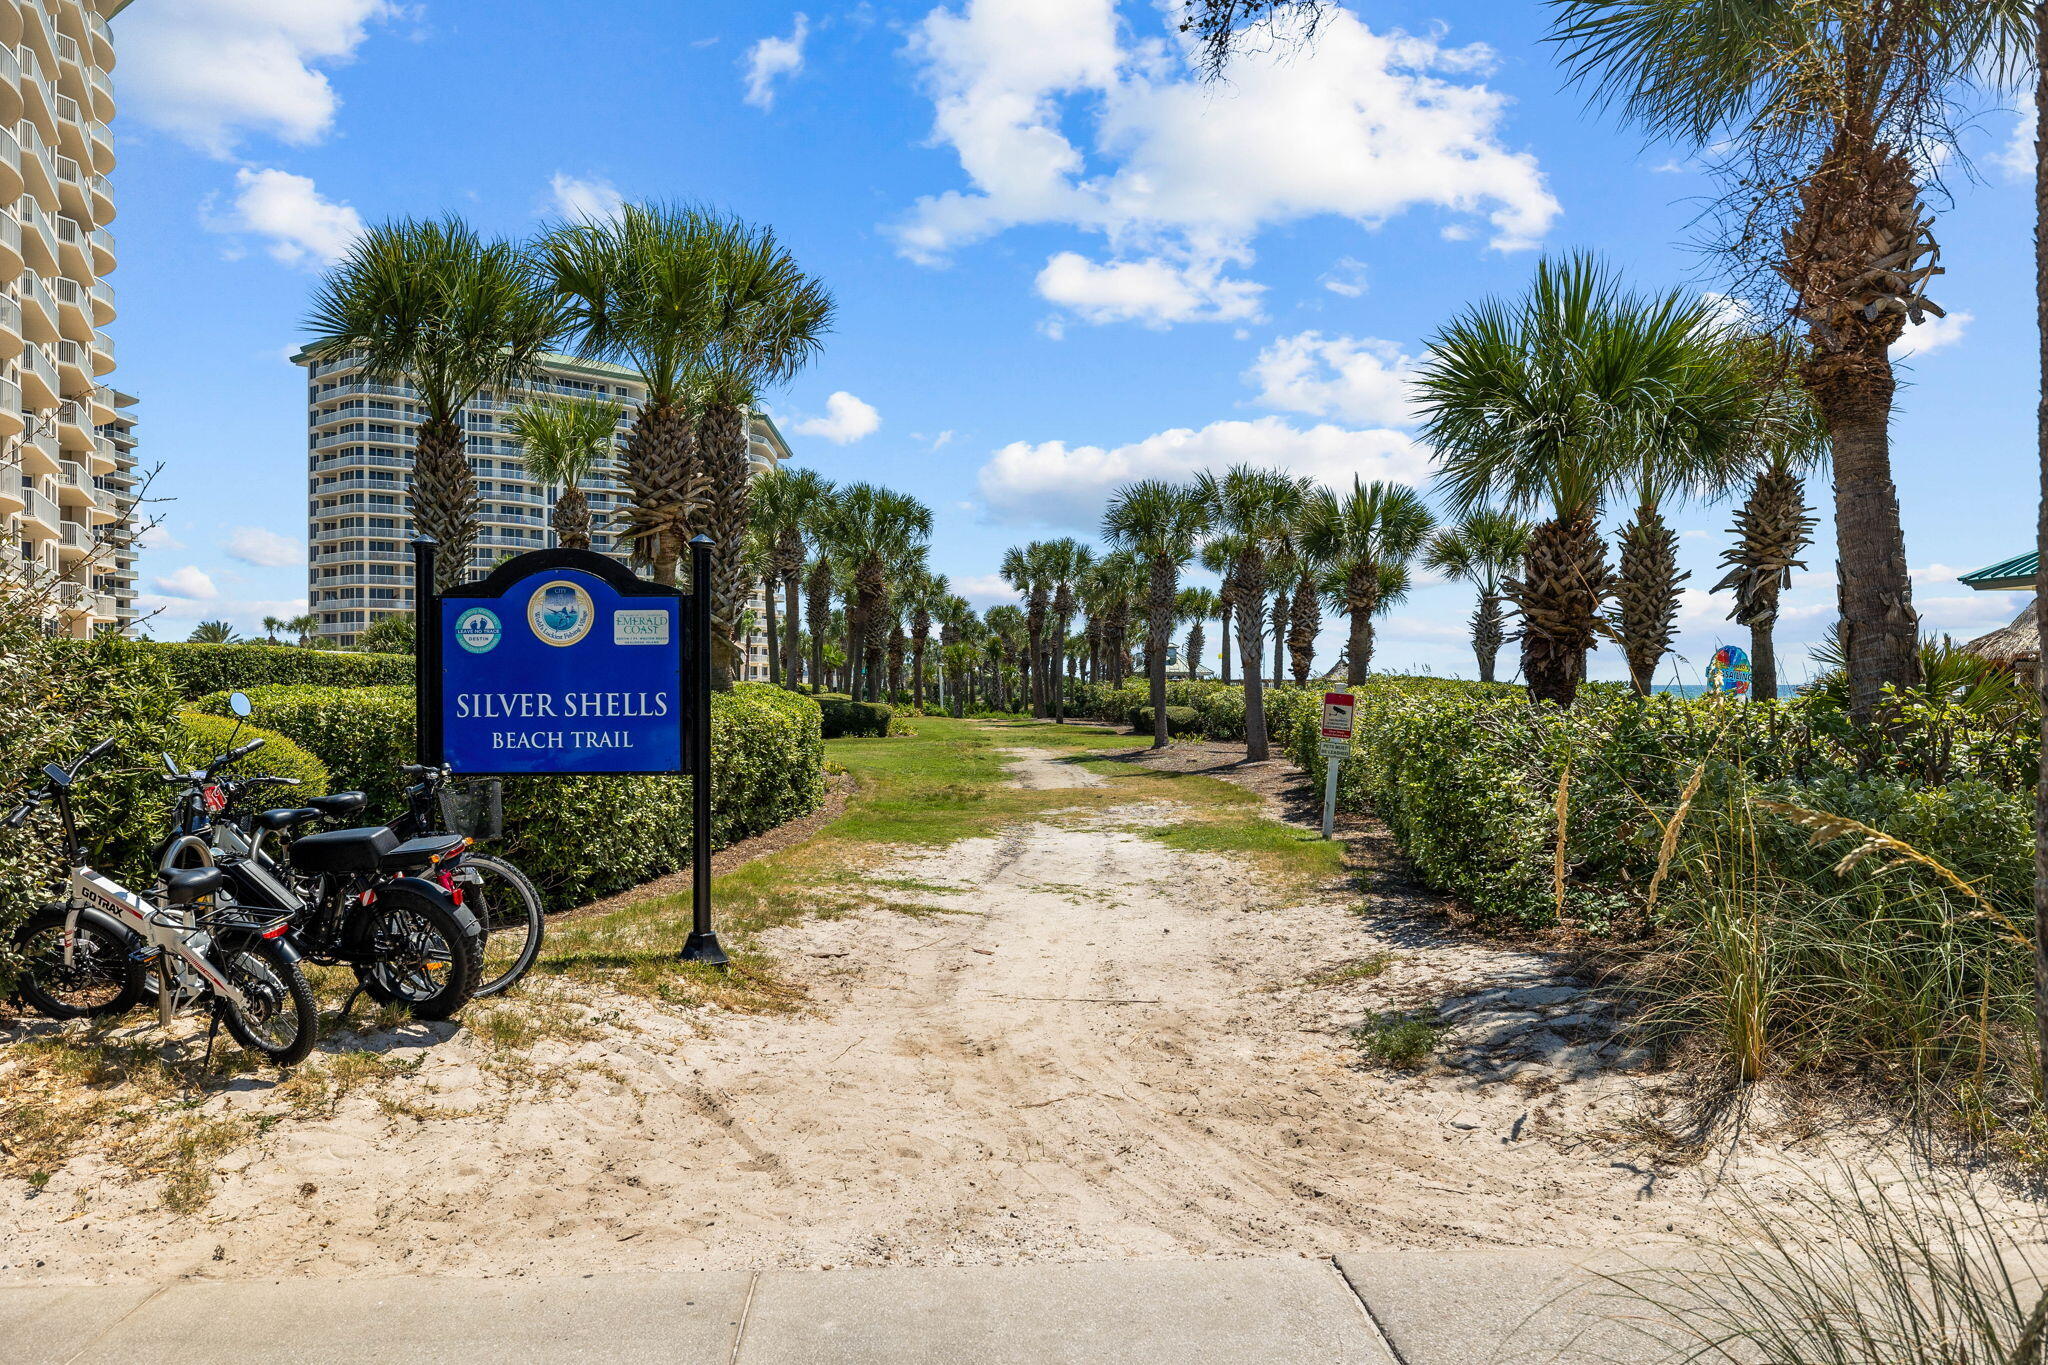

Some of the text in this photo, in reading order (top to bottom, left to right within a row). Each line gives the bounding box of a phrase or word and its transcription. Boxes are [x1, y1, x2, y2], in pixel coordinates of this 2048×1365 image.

[615, 616, 668, 626] EMERALD
[623, 625, 659, 635] COAST
[456, 692, 668, 718] SILVER SHELLS
[492, 731, 634, 749] BEACH TRAIL
